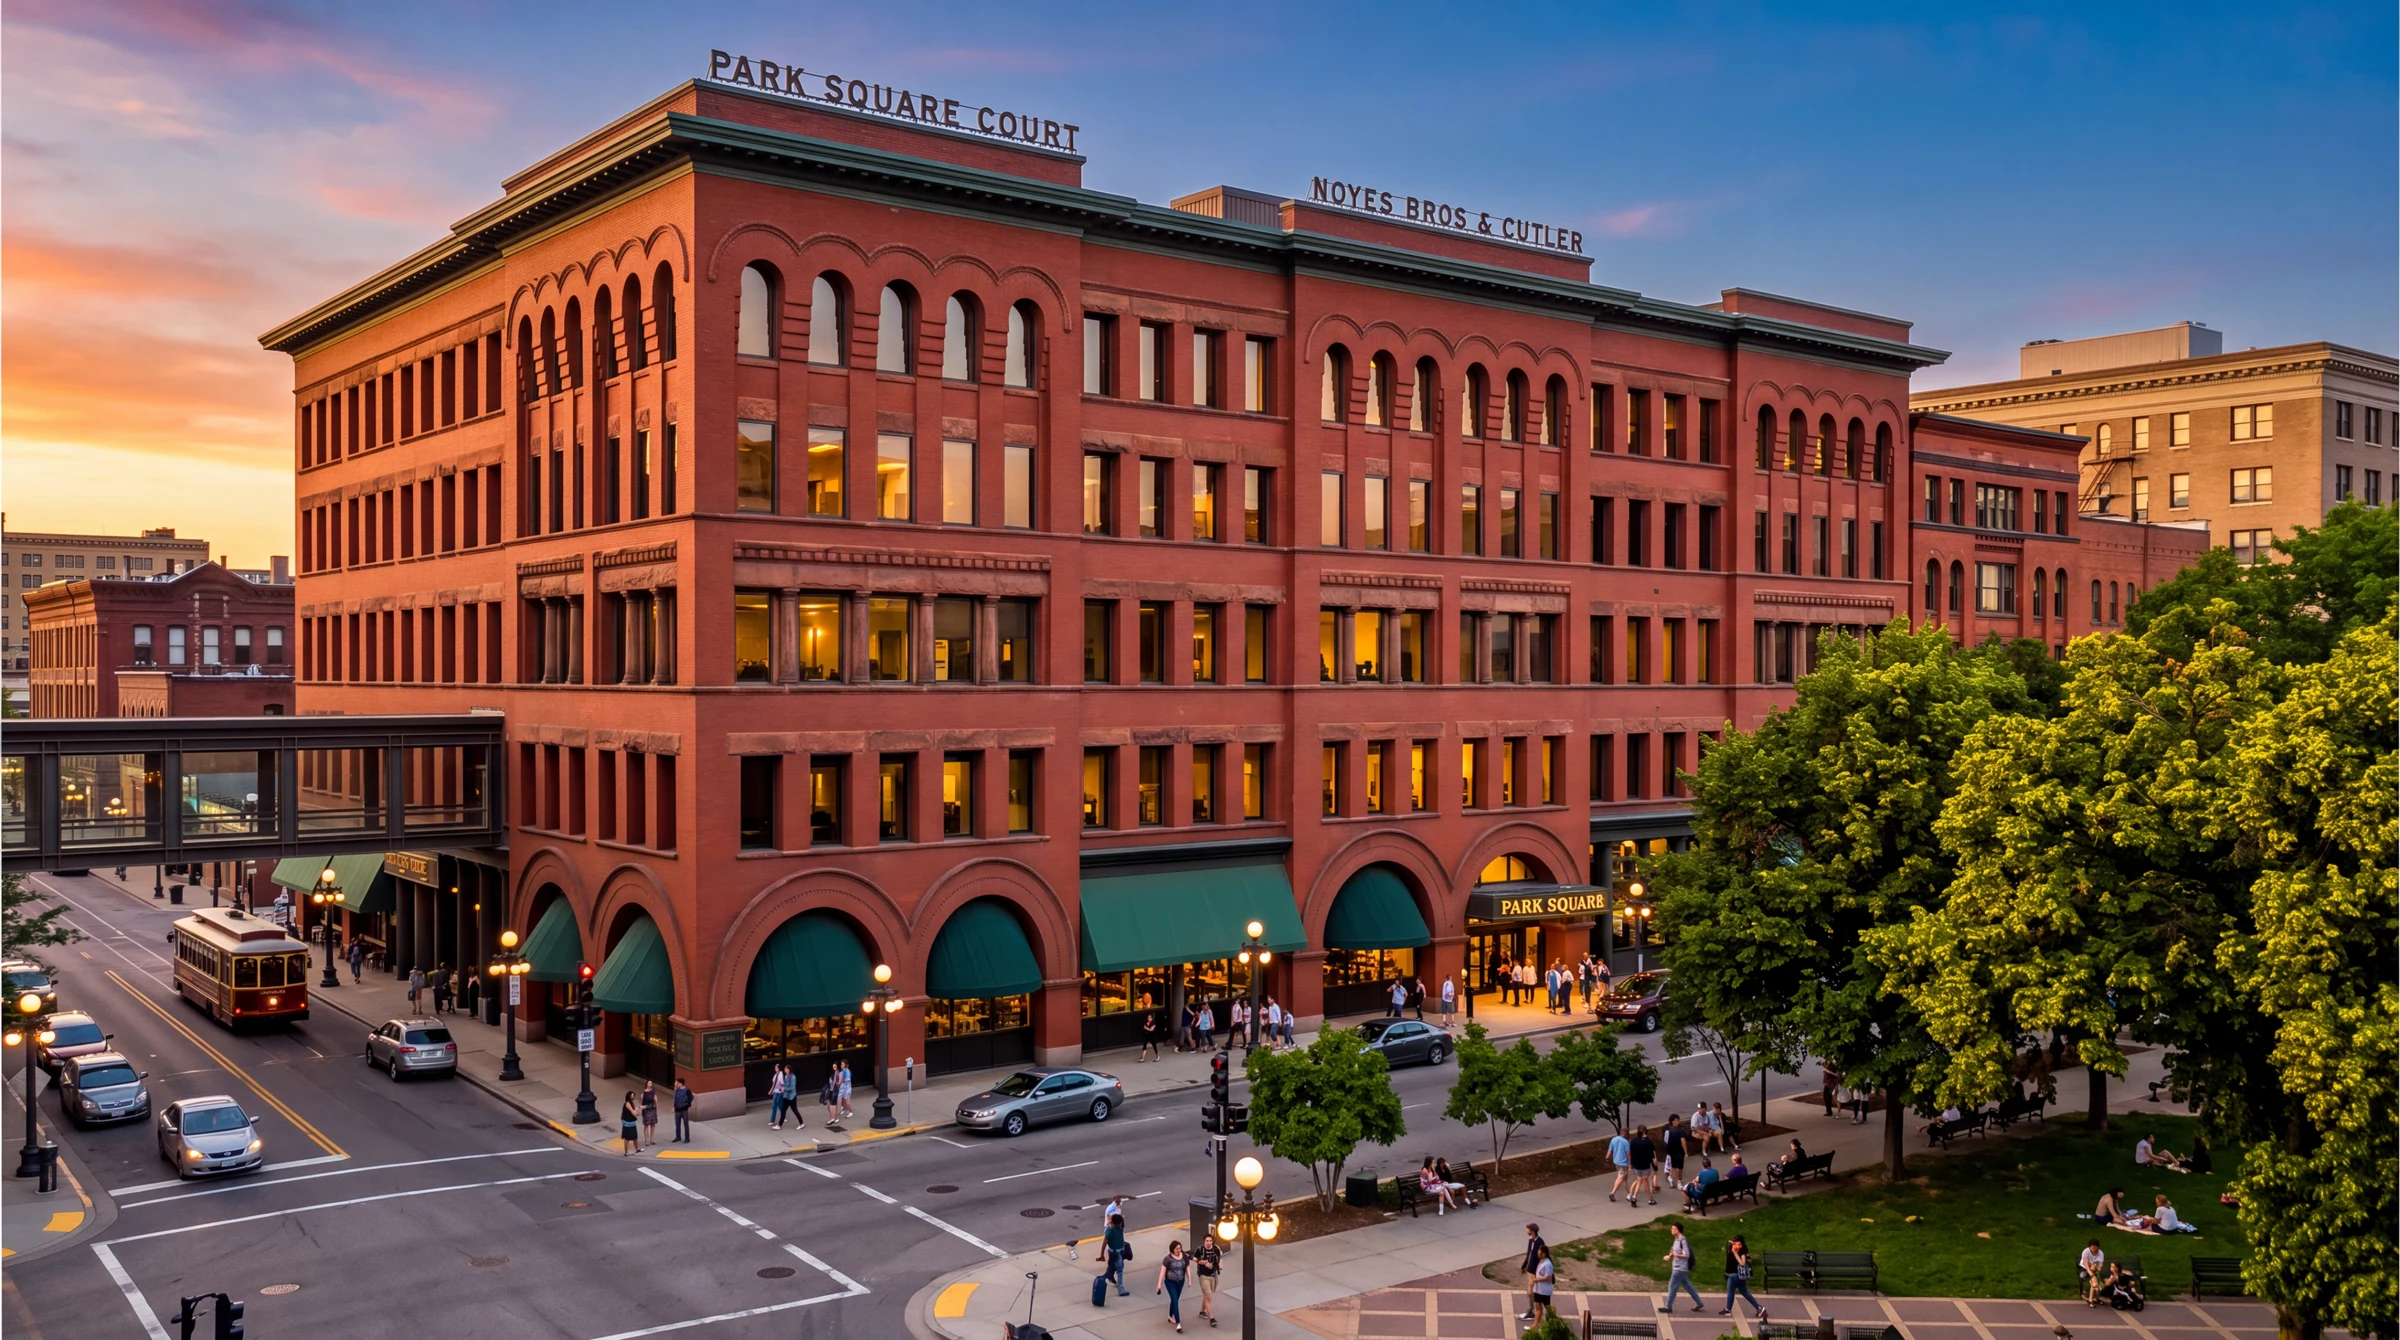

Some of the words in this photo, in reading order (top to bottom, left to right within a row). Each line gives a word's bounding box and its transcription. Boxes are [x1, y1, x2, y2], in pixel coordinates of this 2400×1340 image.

[710, 49, 805, 97] PARK
[824, 74, 960, 127] SQUARE
[977, 107, 1080, 150] COURT
[1312, 176, 1393, 214] NOYES
[1406, 196, 1467, 230] BROS
[1478, 212, 1492, 235] &
[1502, 217, 1583, 254] CUTLER
[1501, 898, 1544, 915] PARK
